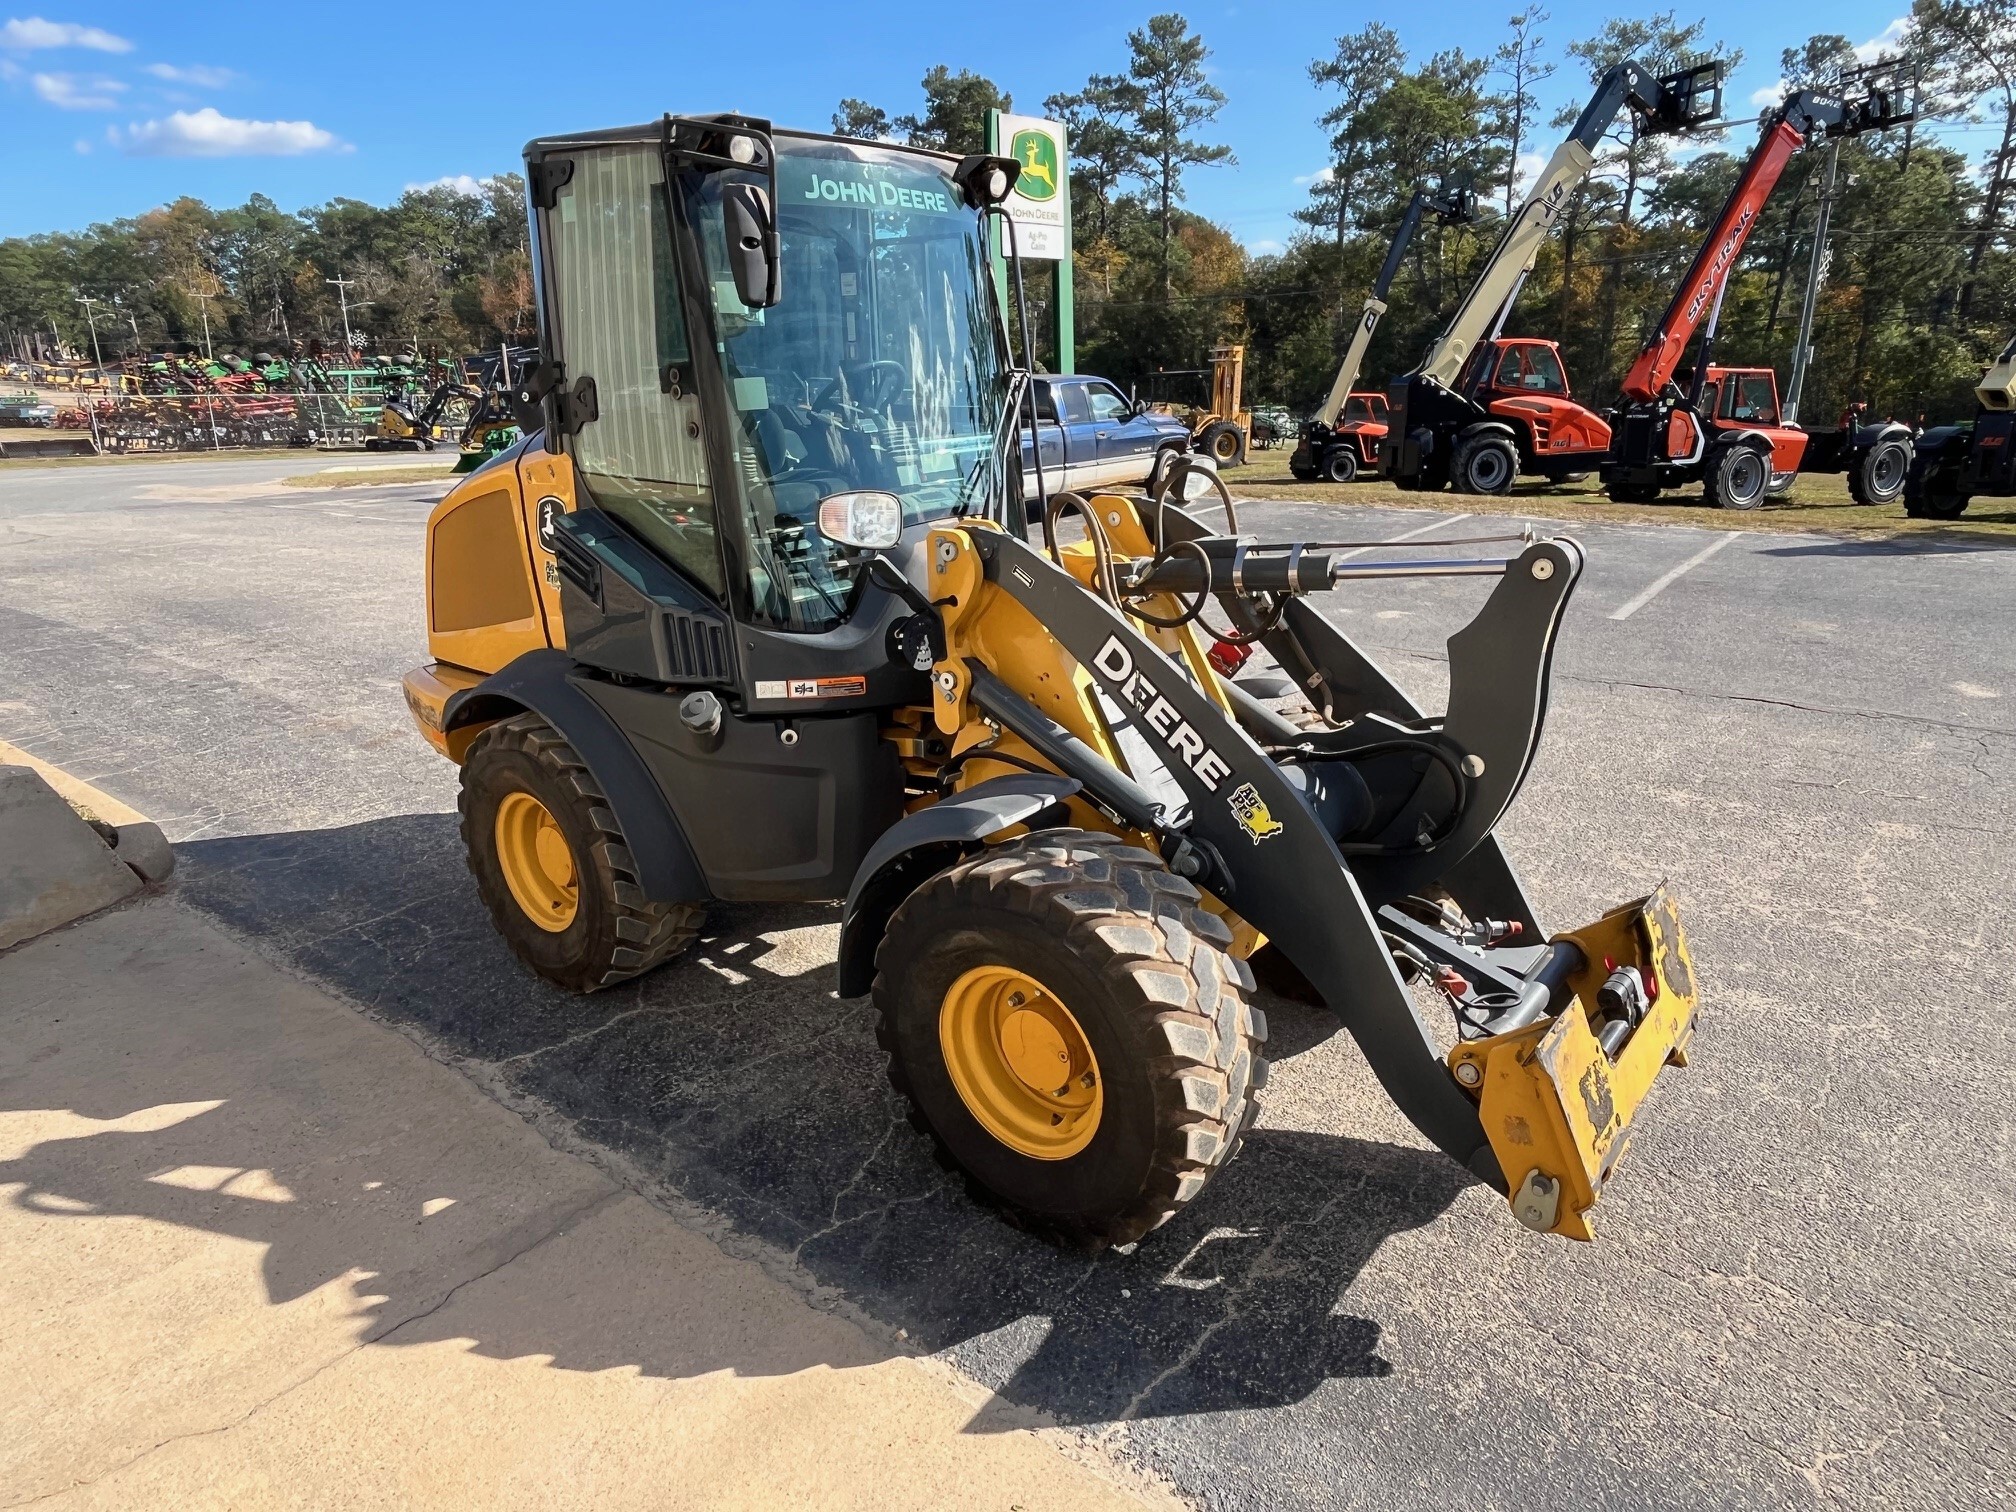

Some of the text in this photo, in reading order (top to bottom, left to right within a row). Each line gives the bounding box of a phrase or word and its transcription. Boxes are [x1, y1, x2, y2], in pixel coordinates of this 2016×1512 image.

[805, 174, 948, 212] JOHN DEERE
[1012, 206, 1059, 221] JOHN DEERE
[1687, 202, 1754, 324] SKYTRAK
[1093, 634, 1232, 793] DEERE
